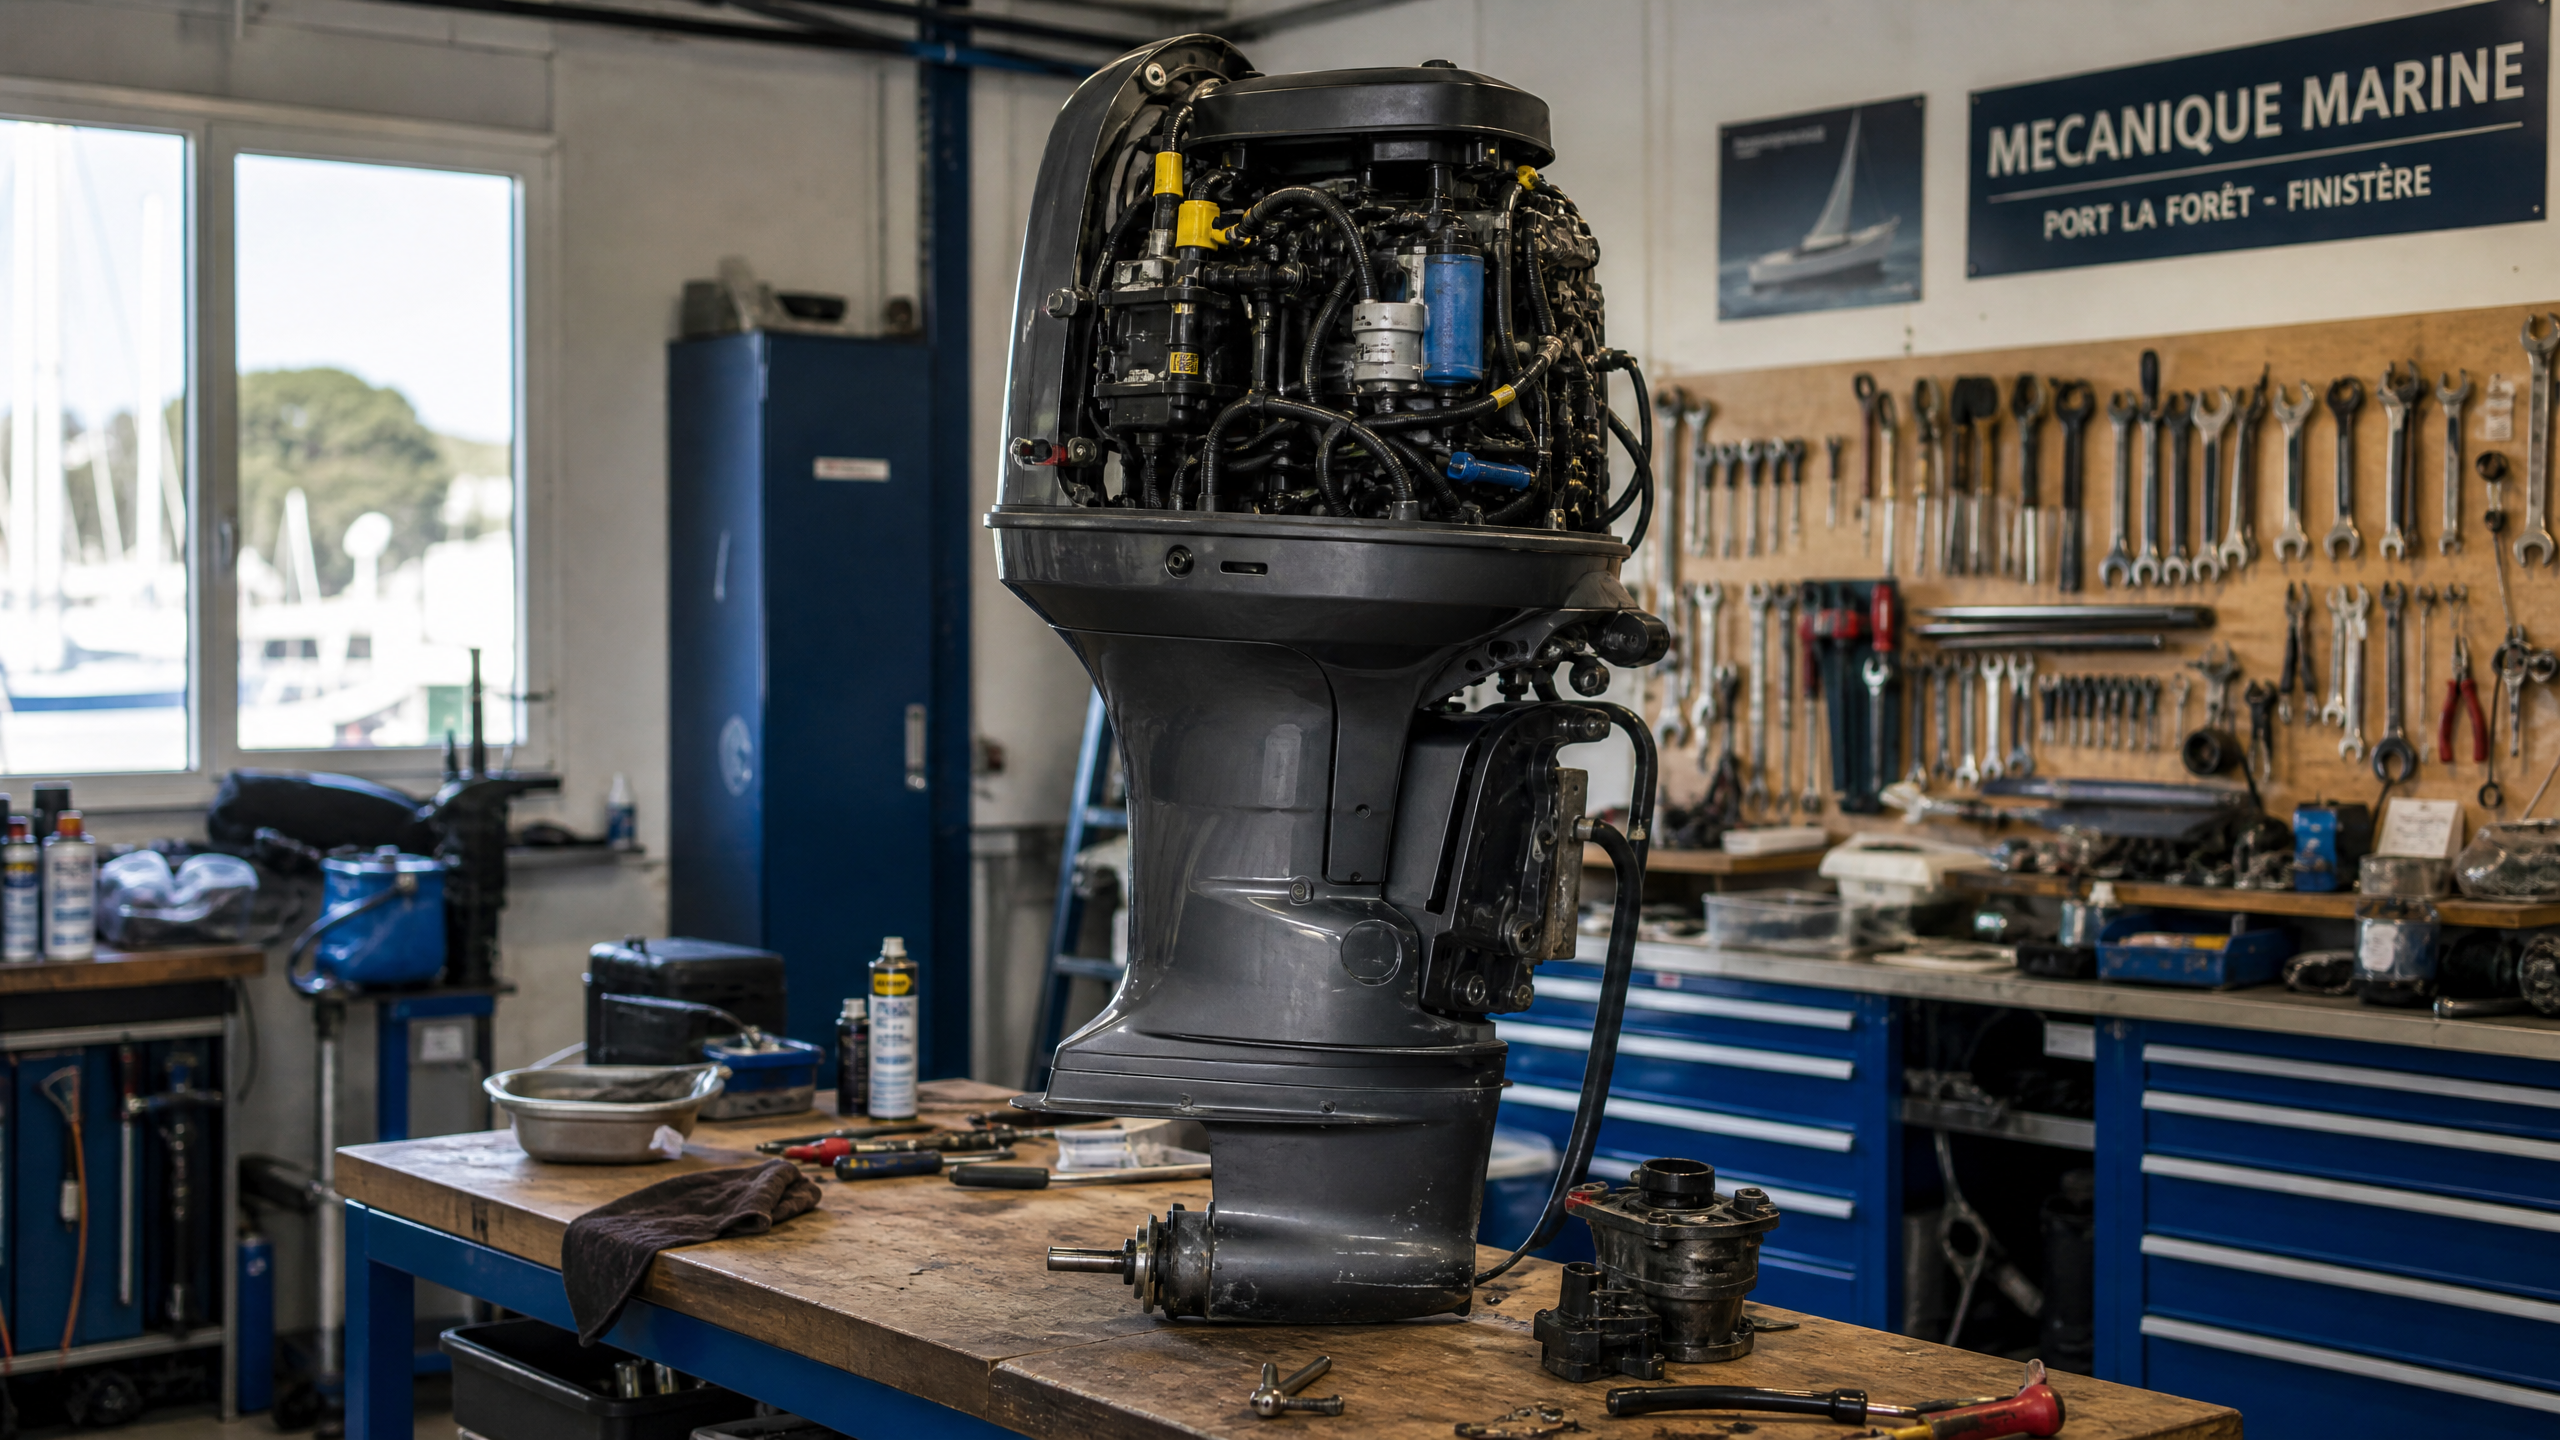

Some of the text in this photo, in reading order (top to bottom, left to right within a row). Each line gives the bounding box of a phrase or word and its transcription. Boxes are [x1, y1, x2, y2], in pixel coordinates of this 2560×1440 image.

[1987, 41, 2526, 178] MECANIQUE MARINE
[2043, 204, 2111, 241] PORT
[2121, 200, 2157, 232] LA
[2166, 182, 2254, 226] FORÊT
[2287, 162, 2432, 212] FINISTÈRE
